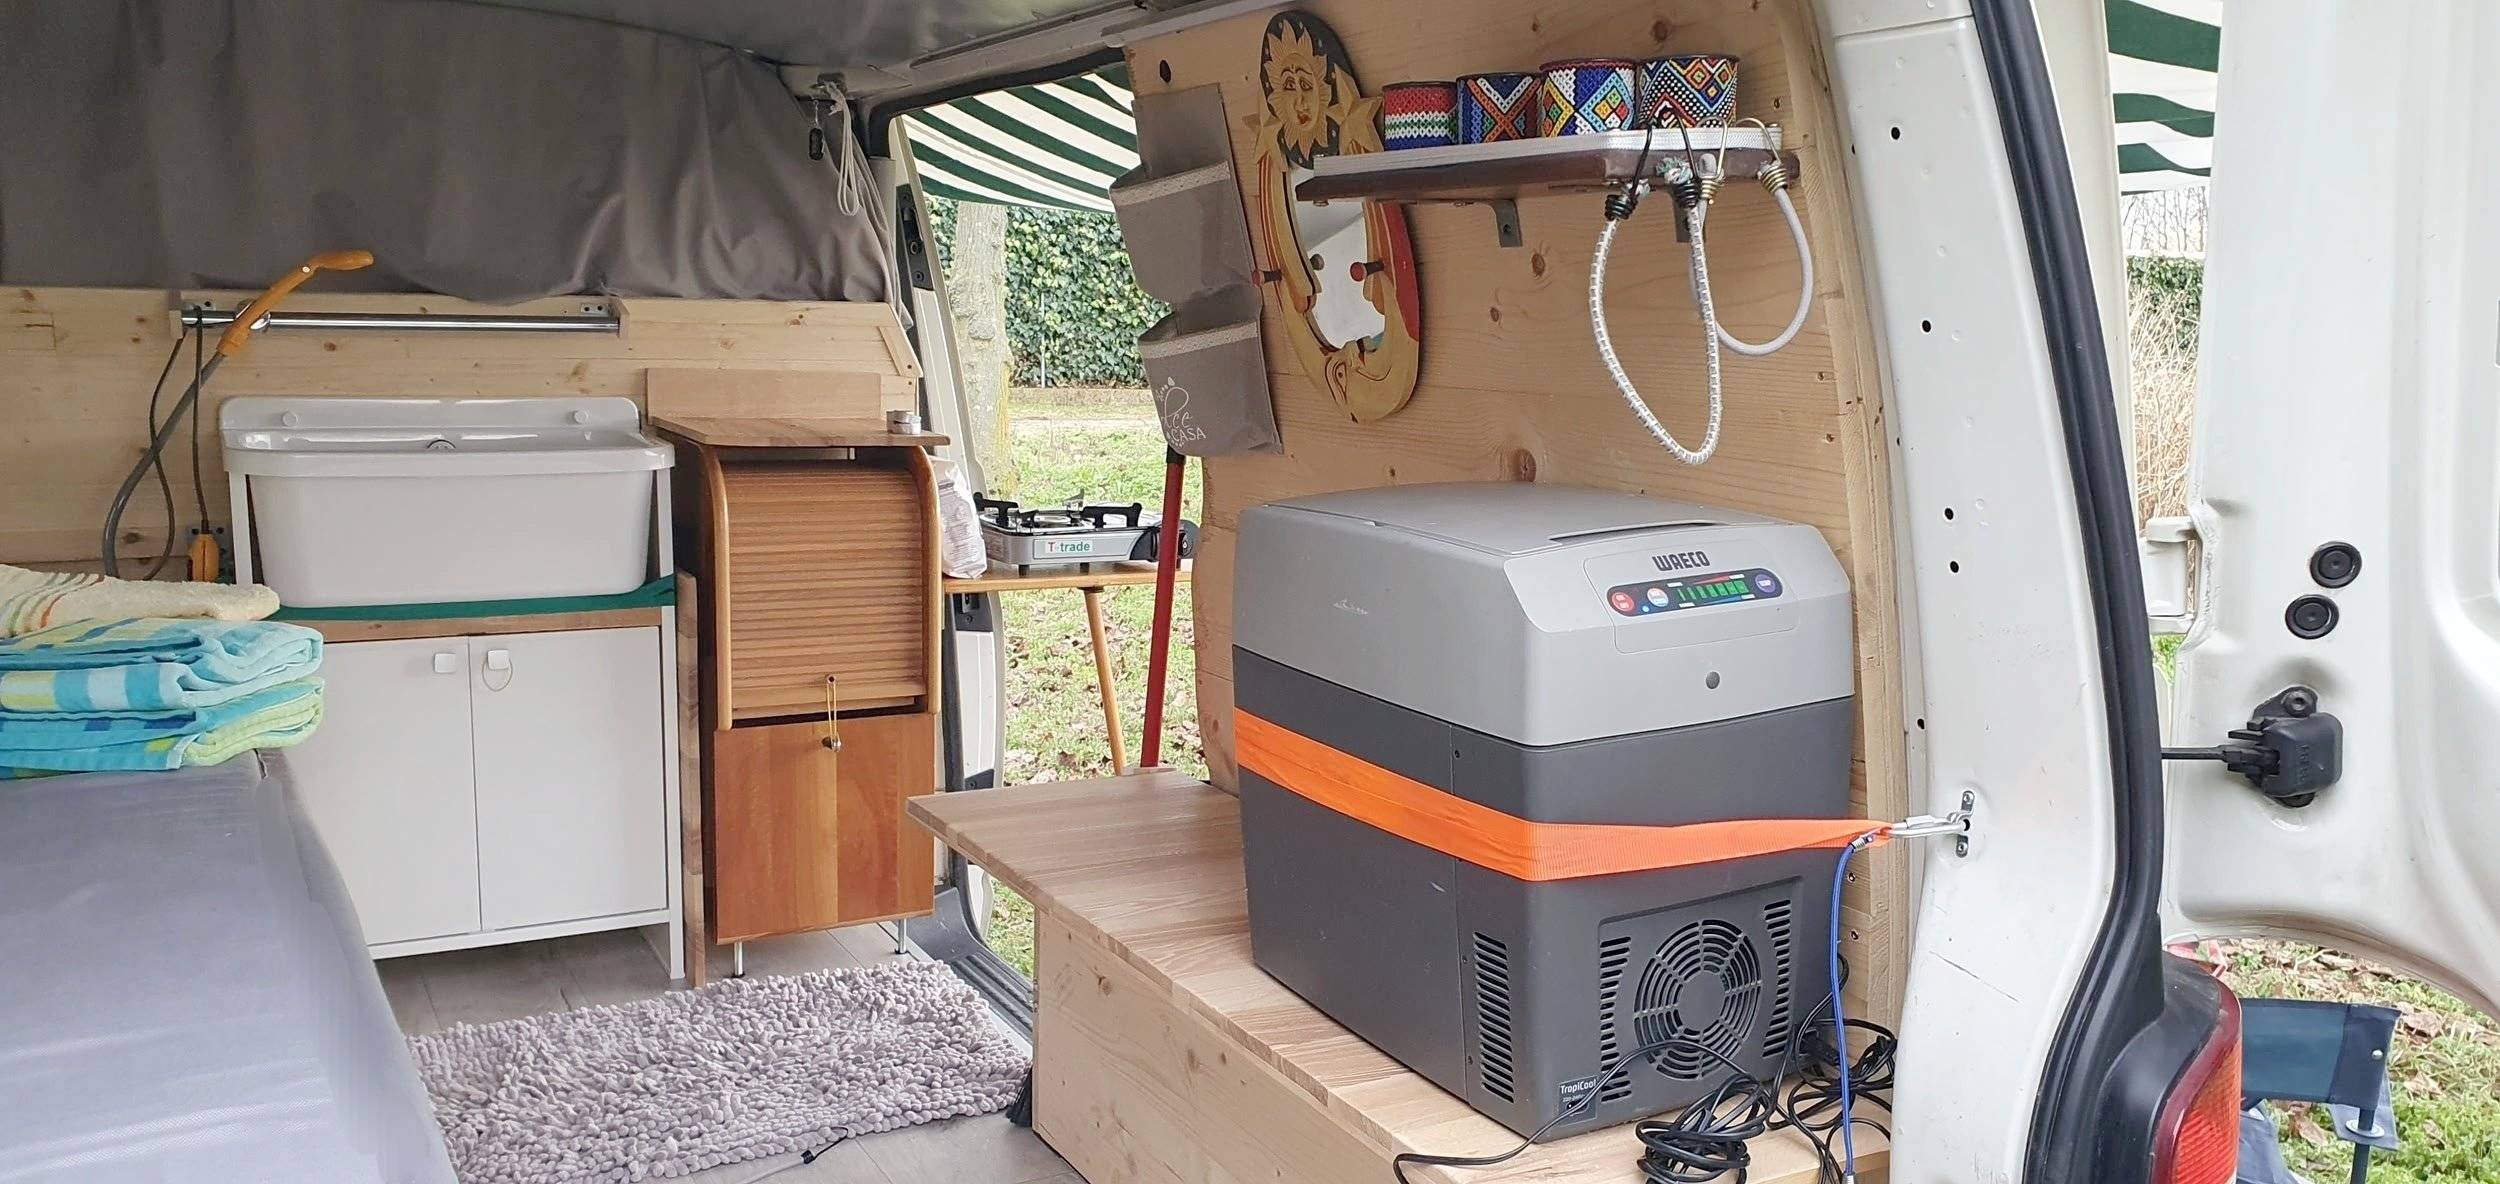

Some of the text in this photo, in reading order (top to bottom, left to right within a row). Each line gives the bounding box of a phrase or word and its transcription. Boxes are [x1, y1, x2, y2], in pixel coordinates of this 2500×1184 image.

[1171, 427, 1207, 442] CASA
[1651, 550, 1711, 572] WAECO
[1560, 1078, 1597, 1095] TropiCool
